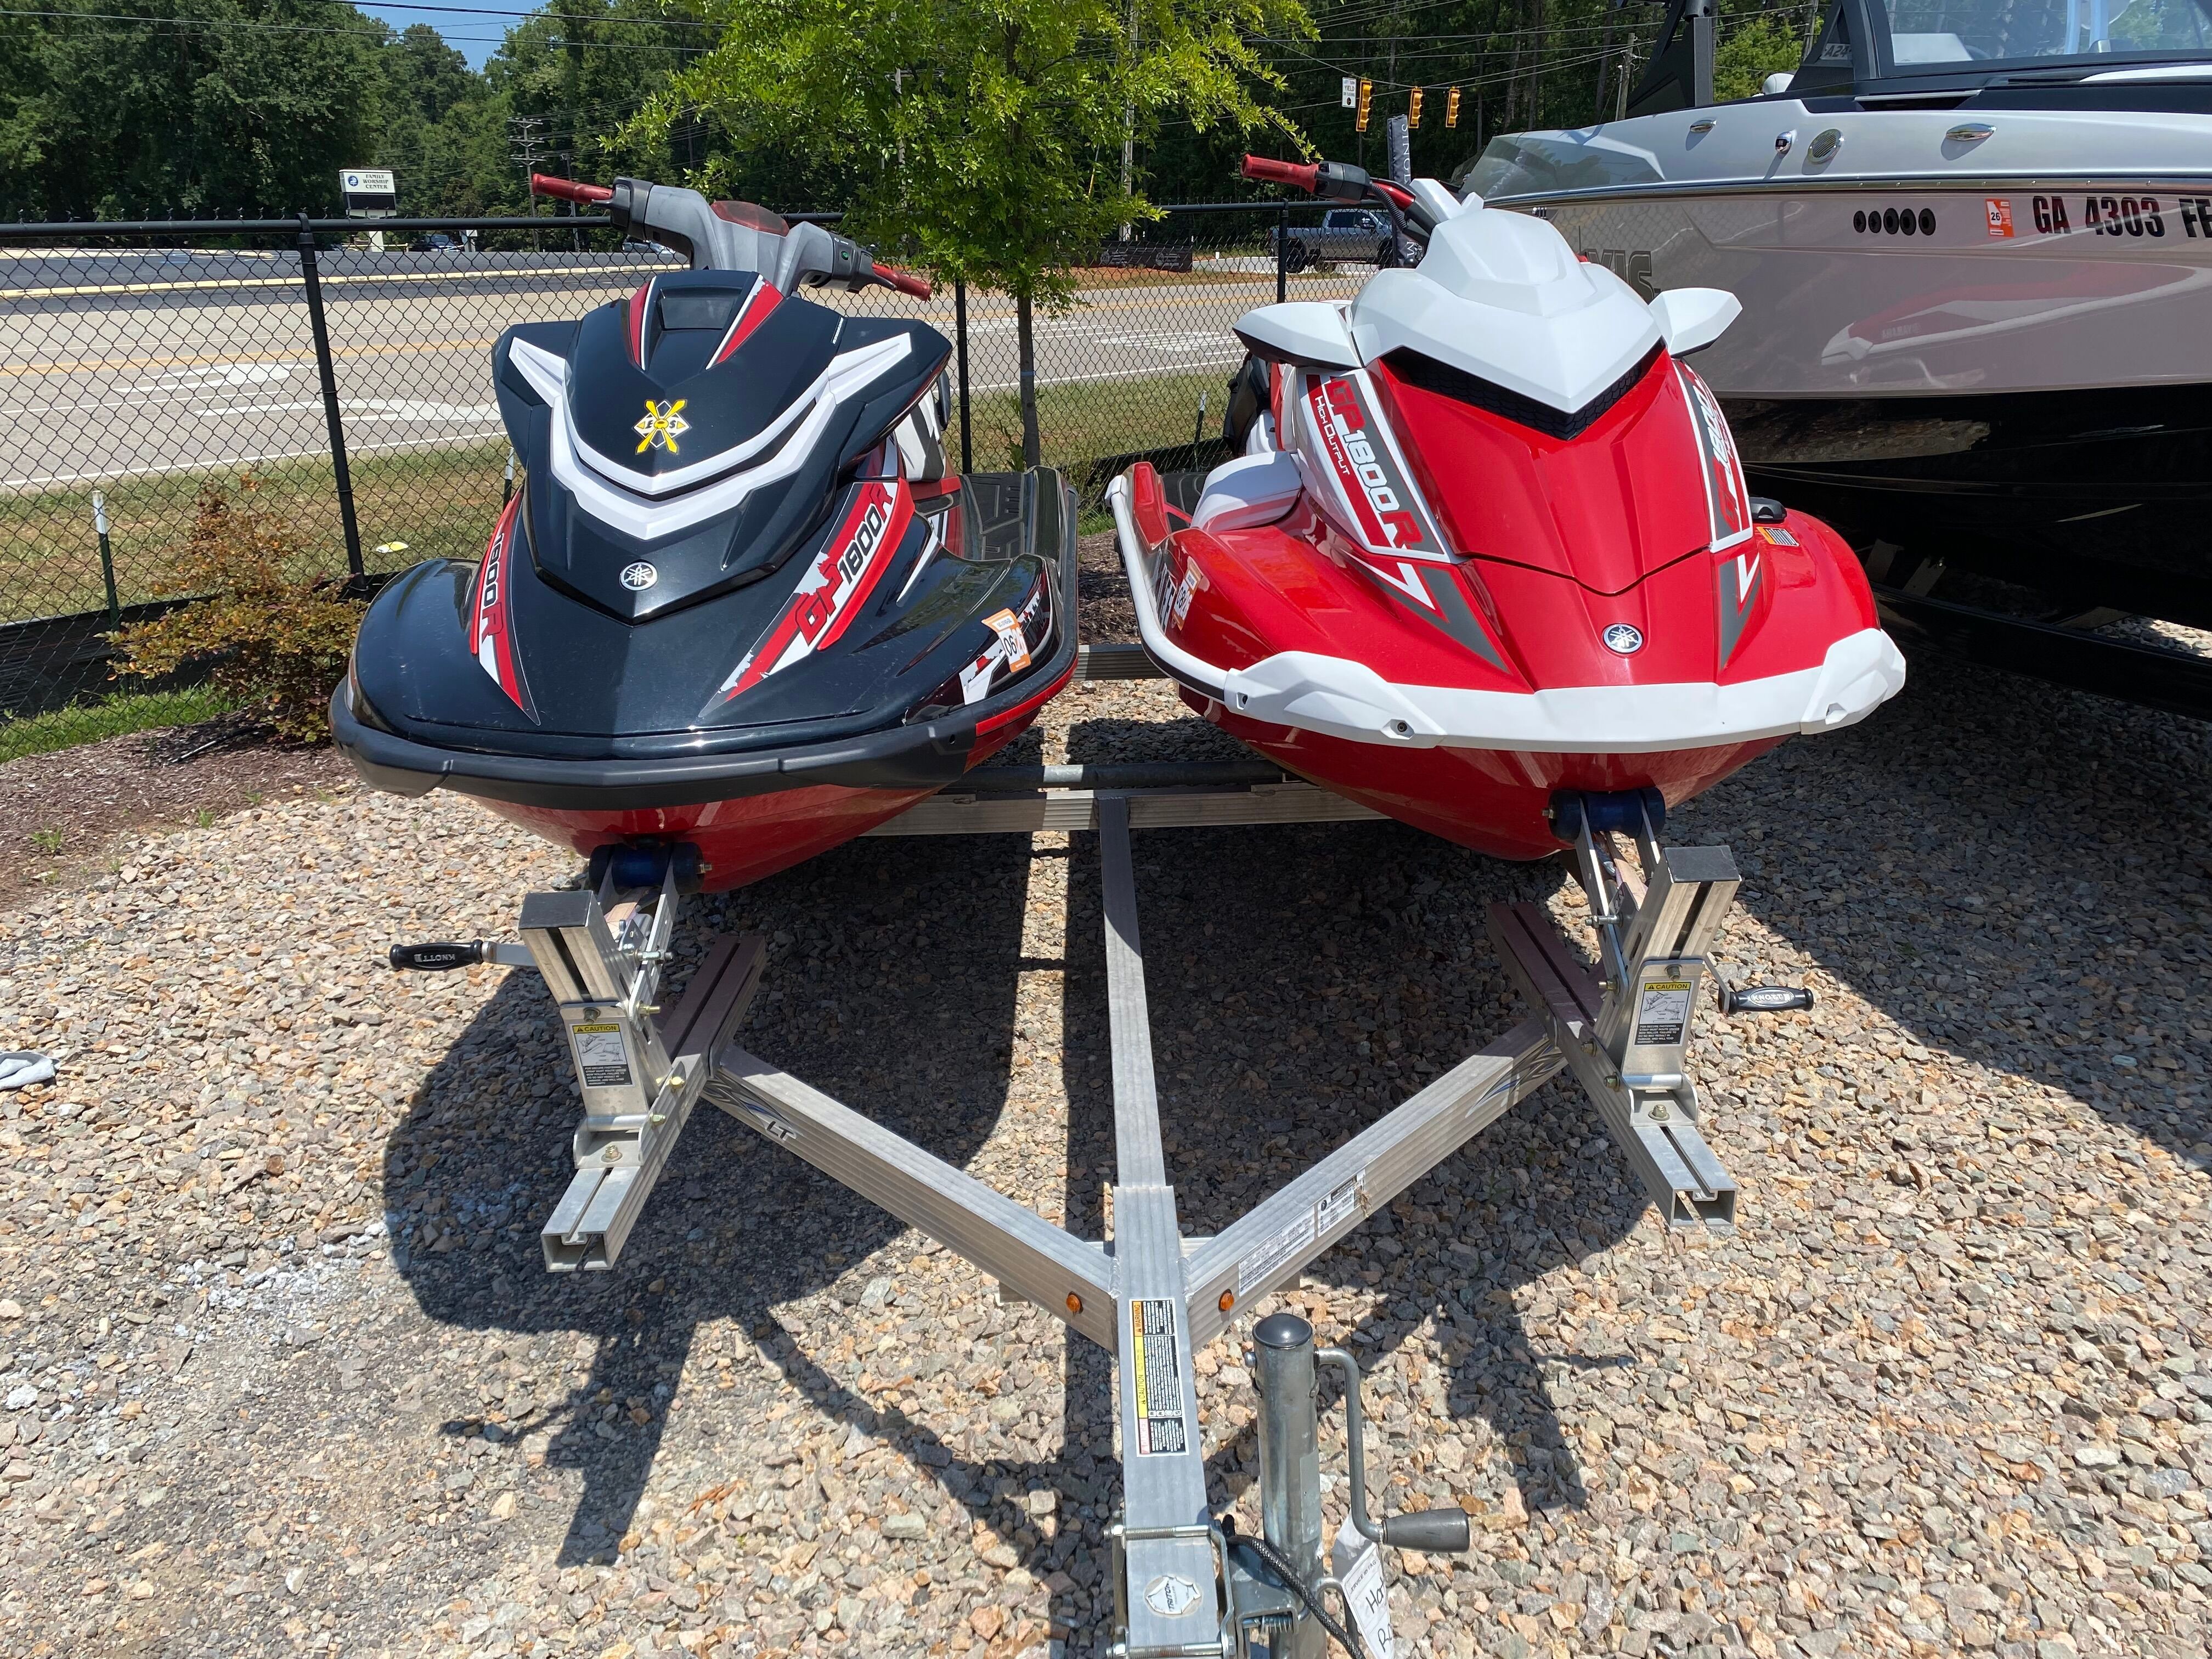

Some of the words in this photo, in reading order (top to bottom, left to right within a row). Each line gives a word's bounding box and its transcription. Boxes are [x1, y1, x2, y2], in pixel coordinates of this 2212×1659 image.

[1990, 212, 2001, 221] 26
[2033, 196, 2072, 234] GA
[2085, 196, 2165, 237] 4303
[1314, 395, 1328, 425] HIGH
[1324, 423, 1350, 476] OUTPUT
[422, 953, 455, 962] KNOTT
[766, 1121, 794, 1139] LT
